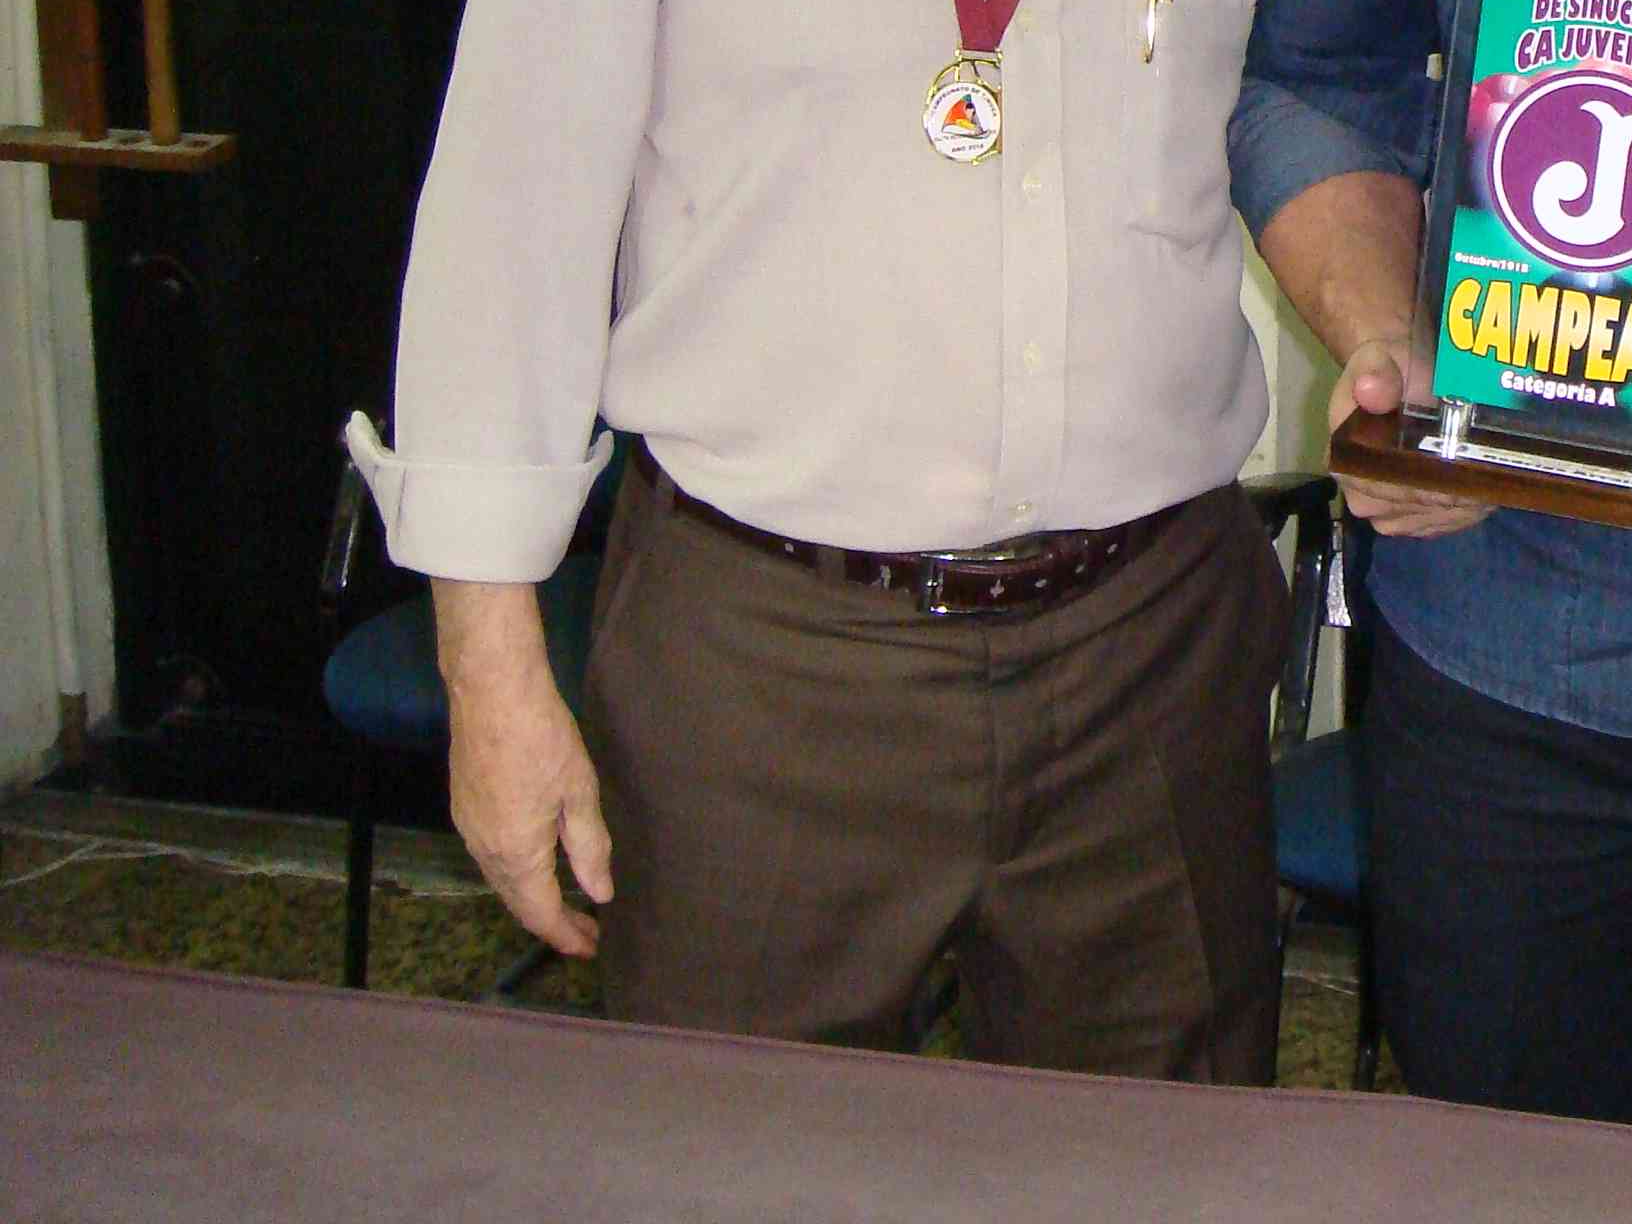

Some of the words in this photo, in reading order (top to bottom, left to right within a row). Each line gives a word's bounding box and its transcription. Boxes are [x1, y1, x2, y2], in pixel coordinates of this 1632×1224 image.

[1516, 27, 1556, 73] CA
[1500, 370, 1596, 403] Categoria
[1596, 386, 1616, 407] A
